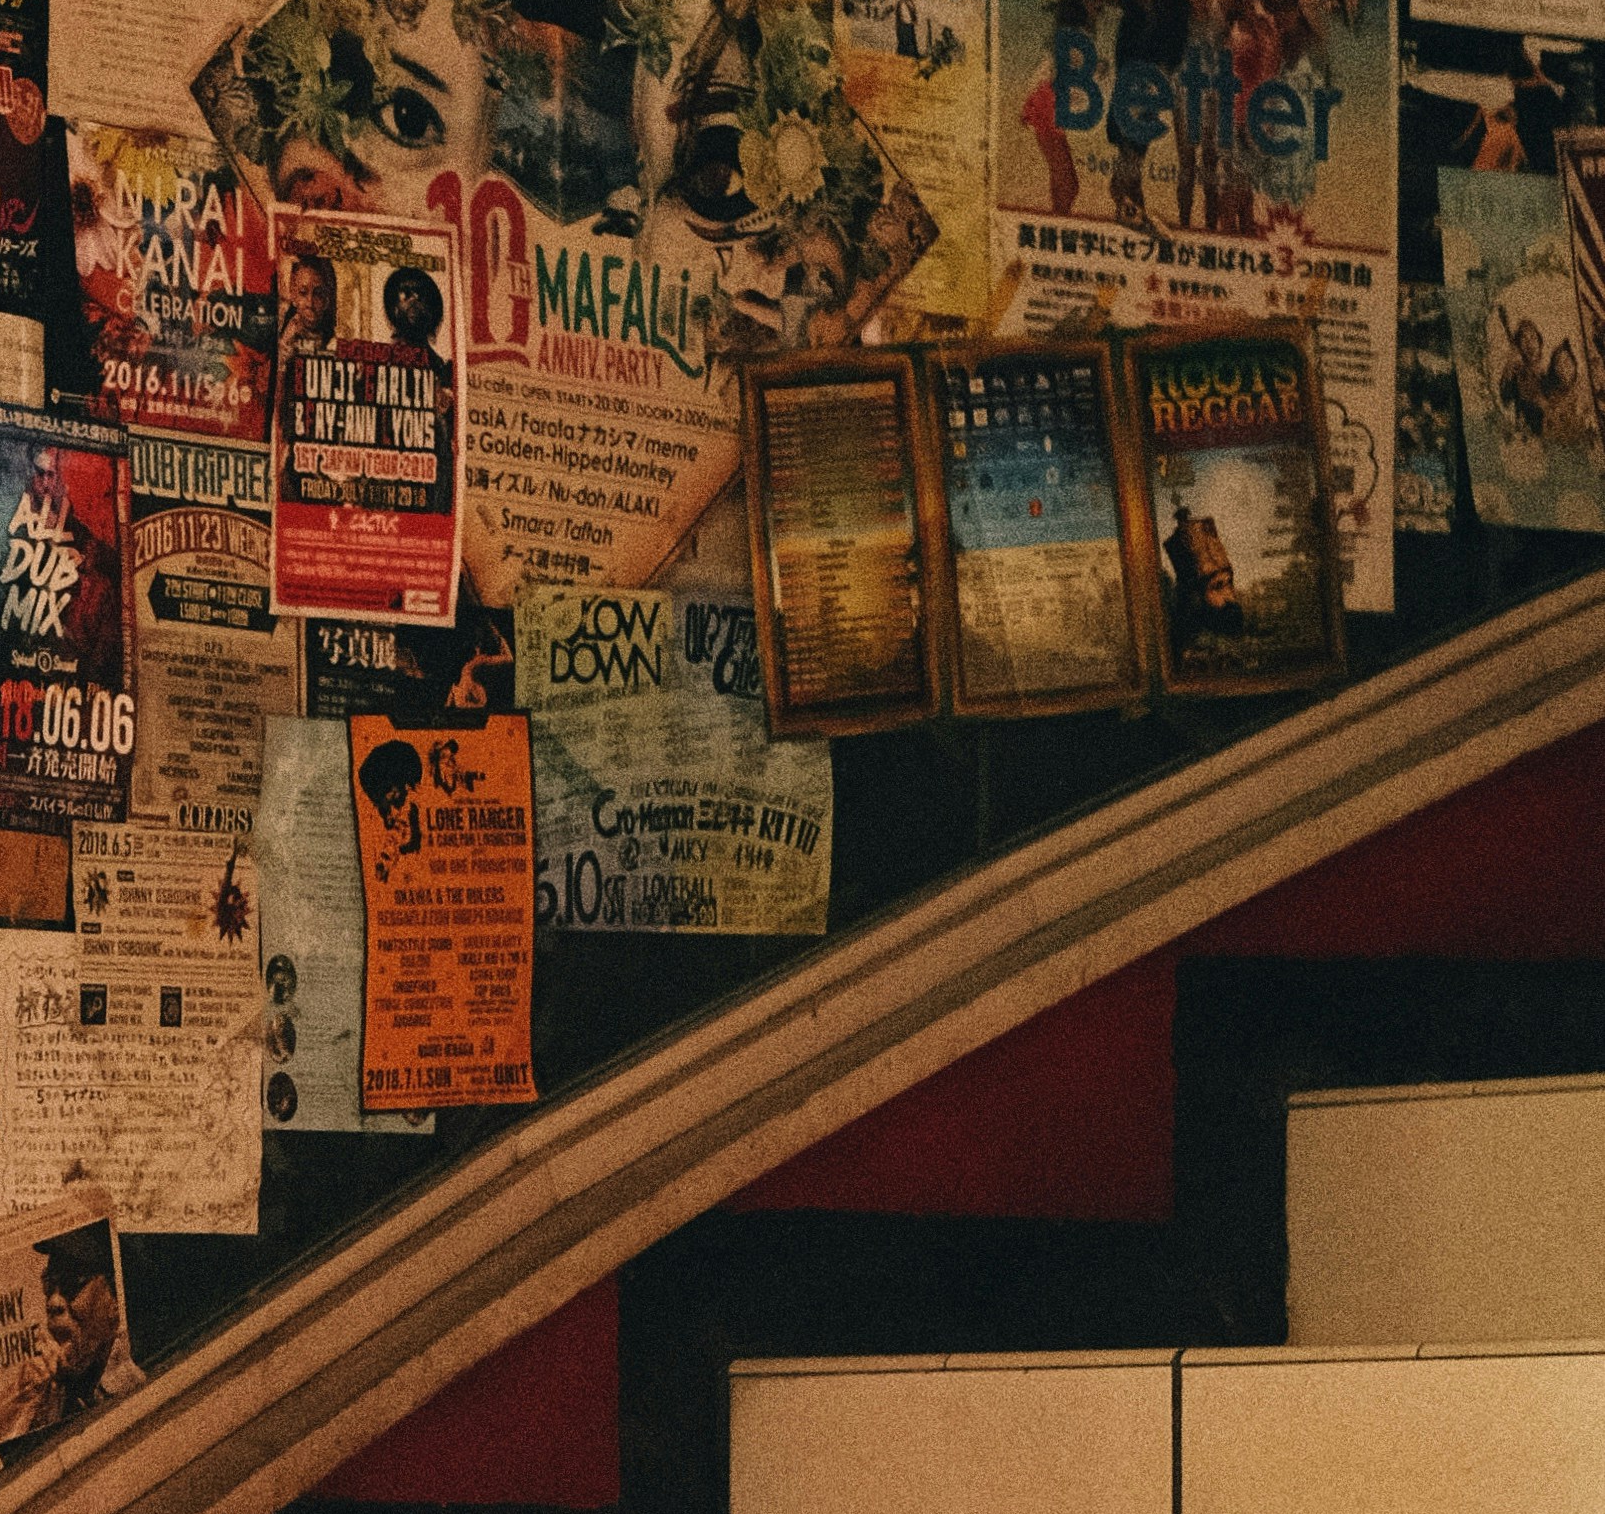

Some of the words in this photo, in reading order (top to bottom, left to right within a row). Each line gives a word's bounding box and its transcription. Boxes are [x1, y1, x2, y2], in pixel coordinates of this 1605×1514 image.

[1053, 27, 1341, 164] Better
[116, 172, 244, 236] NIRAI
[116, 235, 244, 297] KANAI
[116, 289, 244, 329] CELEBRATION
[604, 347, 663, 388] PARTY
[0, 542, 82, 589] DUB
[1, 588, 70, 638] MIX
[550, 639, 662, 686] DOWN
